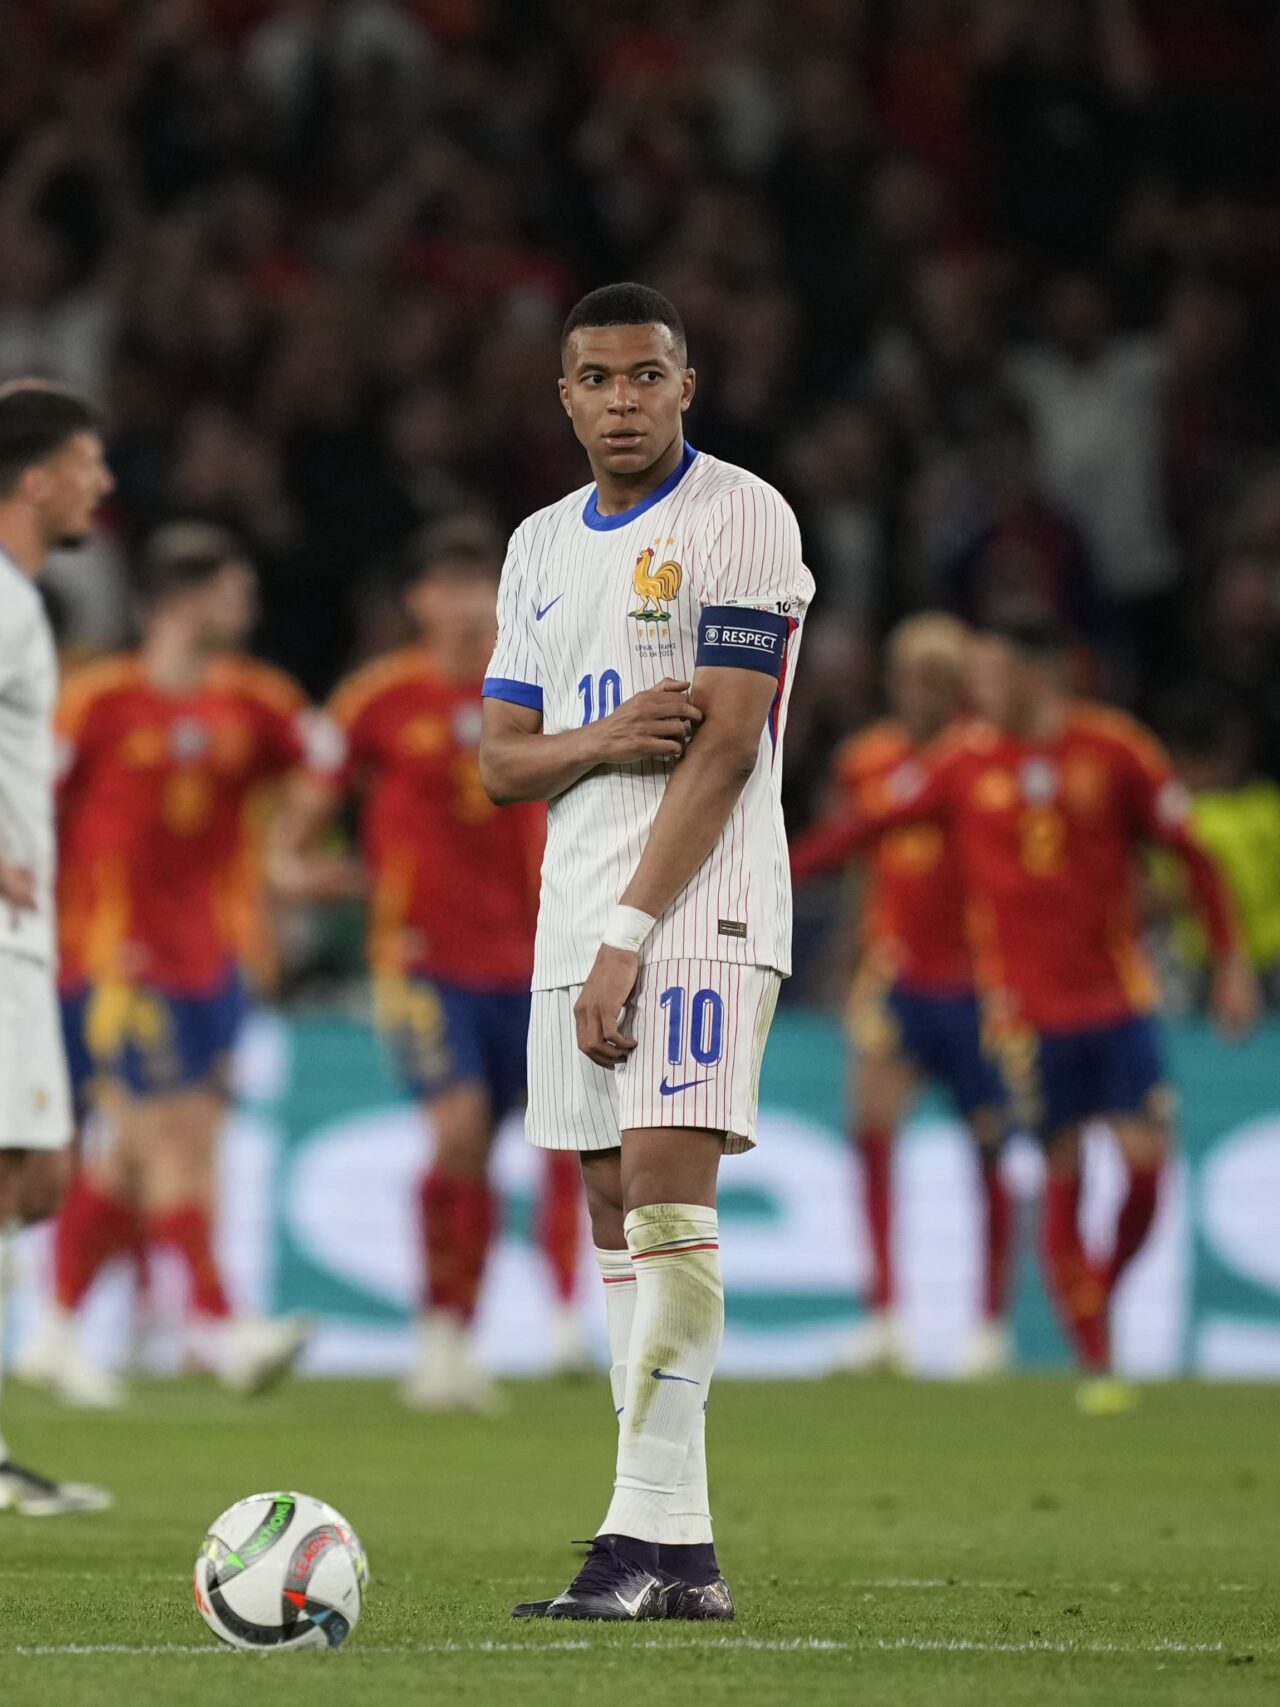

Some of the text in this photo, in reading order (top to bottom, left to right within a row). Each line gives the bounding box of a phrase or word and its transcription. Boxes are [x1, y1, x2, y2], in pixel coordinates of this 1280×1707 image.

[776, 601, 791, 614] 10
[722, 630, 777, 649] RESPECT
[578, 669, 622, 727] 10
[660, 986, 724, 1067] 10
